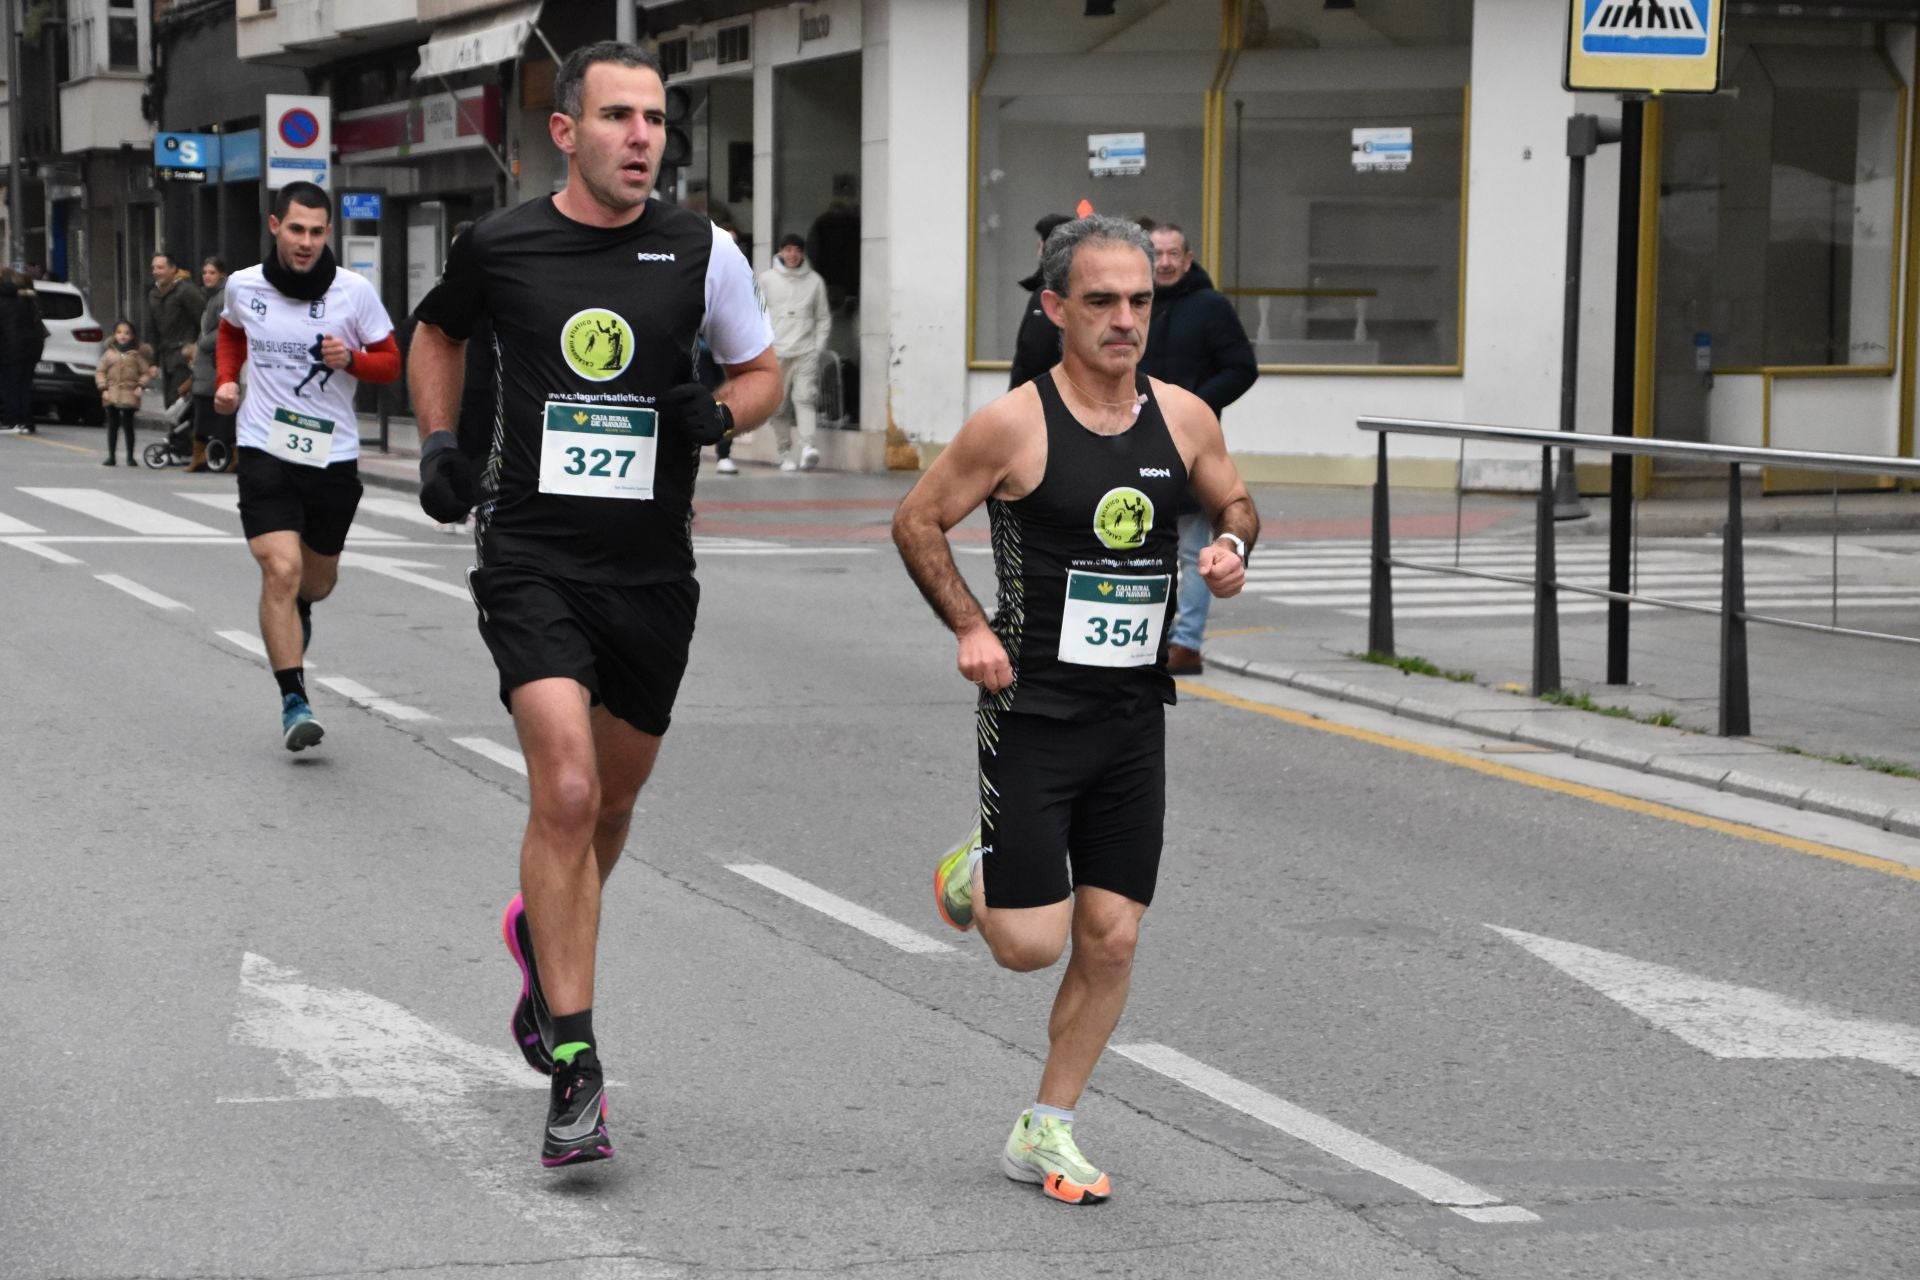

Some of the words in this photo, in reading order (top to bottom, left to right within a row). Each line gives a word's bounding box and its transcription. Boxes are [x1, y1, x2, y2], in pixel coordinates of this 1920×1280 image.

[179, 140, 199, 164] S
[343, 195, 358, 207] 07
[266, 341, 308, 355] SILVESTRE
[590, 414, 608, 422] CAJA
[286, 433, 313, 453] 33
[563, 446, 636, 478] 327
[1115, 590, 1125, 598] DE
[1084, 616, 1149, 647] 354
